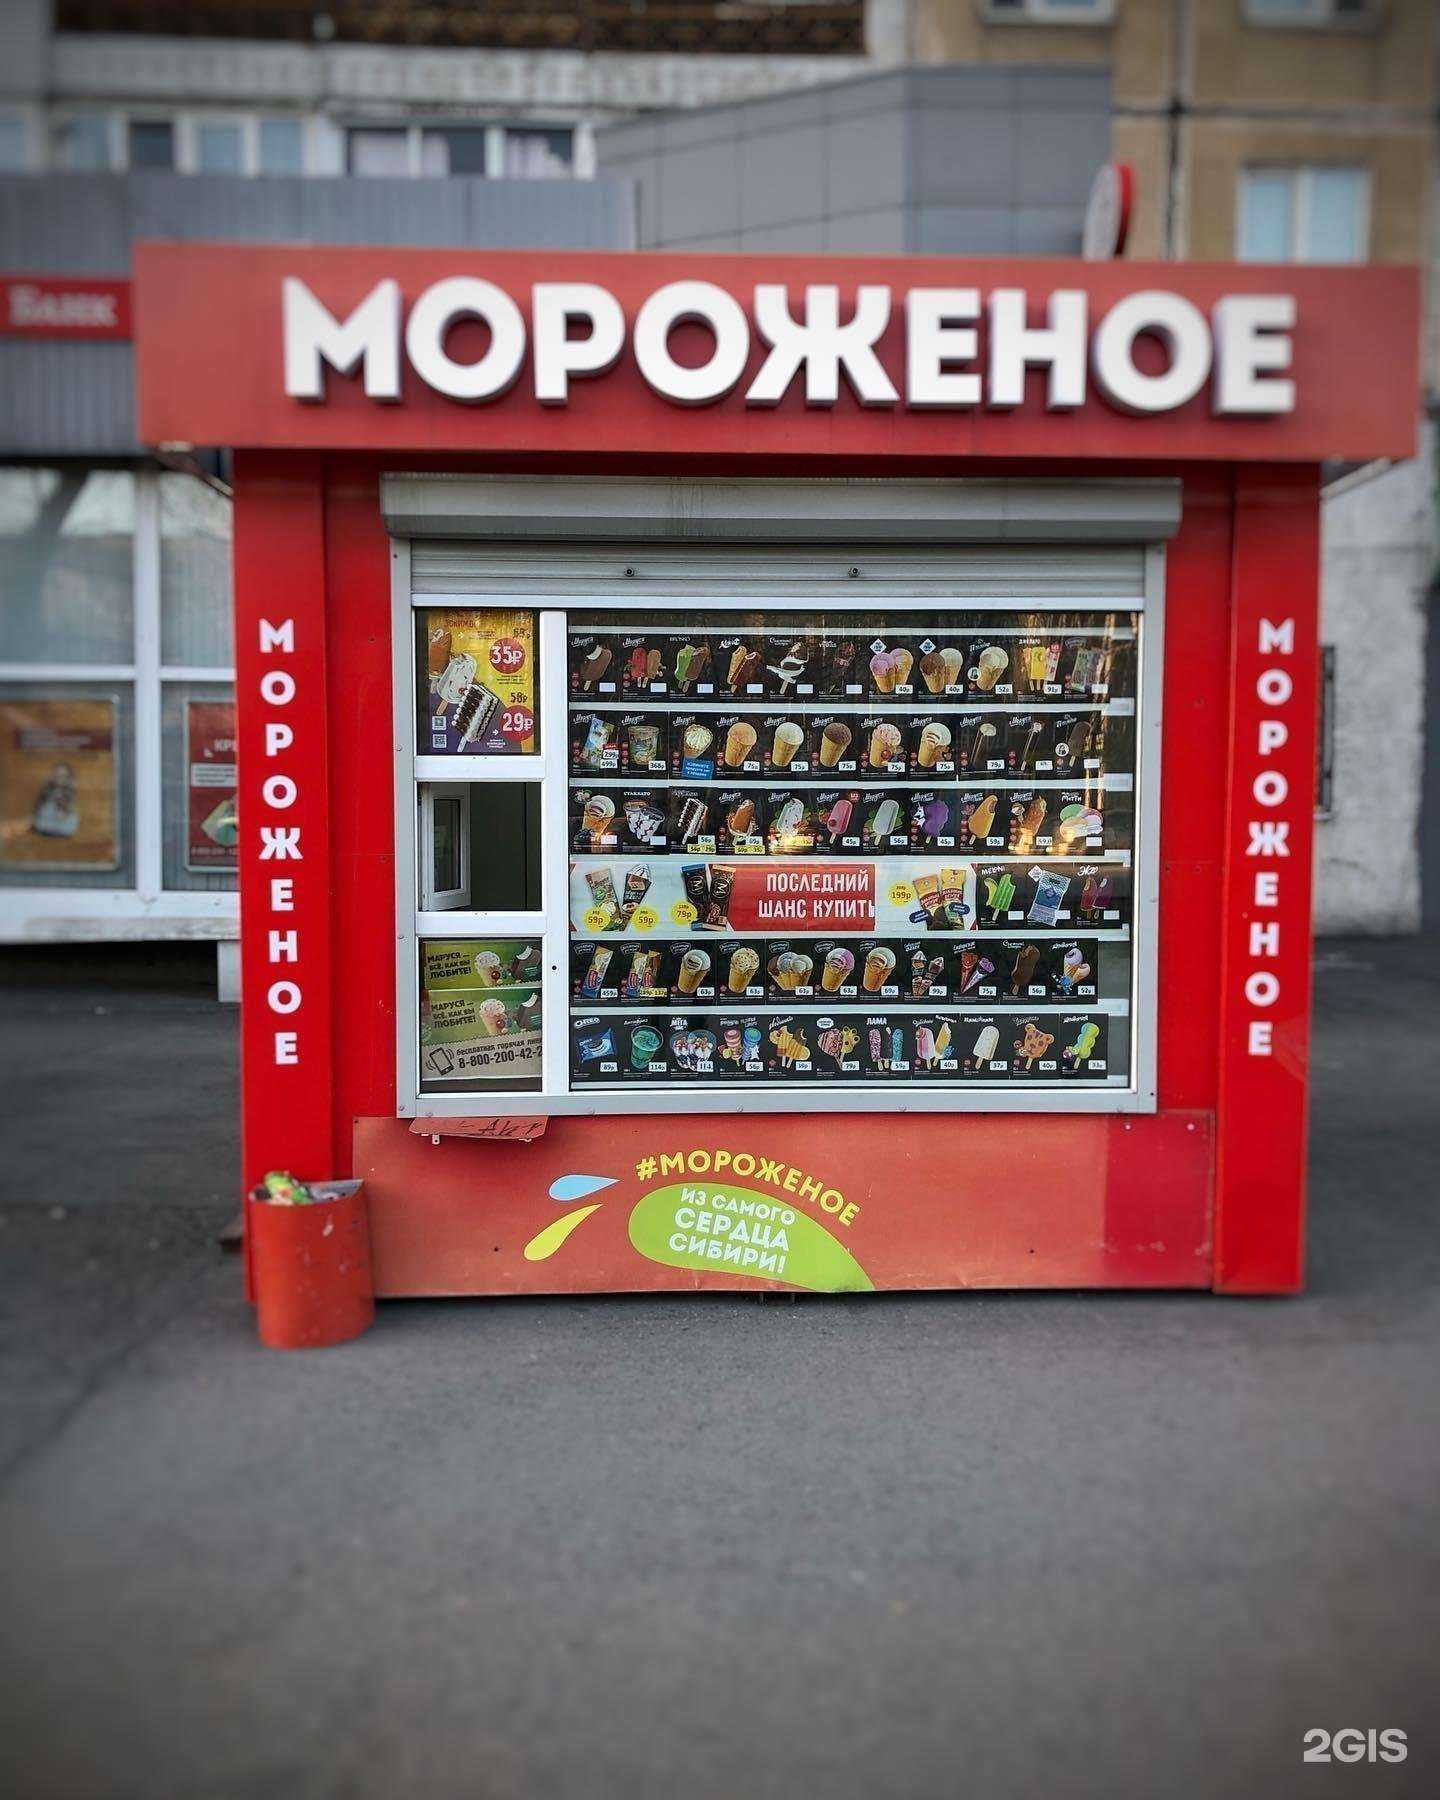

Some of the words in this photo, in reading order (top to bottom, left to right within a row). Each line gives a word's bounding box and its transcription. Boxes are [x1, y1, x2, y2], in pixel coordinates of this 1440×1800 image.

[281, 275, 1297, 415] МОРОЖЕНОЕ
[258, 618, 303, 1065] МОРОЖЕНОЕ
[1245, 617, 1295, 1056] МОРОЖЕНОЕ
[767, 869, 869, 893] ПОСЛЕДНИЙ
[758, 899, 807, 918] ШАНС
[813, 899, 875, 918] КУПИТЬ
[427, 951, 461, 963] МАРУСЯ
[430, 967, 472, 979] ЛЮБИТЕ!
[432, 1000, 466, 1012] МАРУСЯ
[434, 1015, 477, 1029] ЛЮБИТЕ!
[866, 1017, 887, 1025] ЛАМА
[457, 1044, 496, 1056] бесплатная
[497, 1041, 525, 1051] горячая
[635, 1149, 860, 1227] #МОРОЖЕНОЕ
[681, 1187, 706, 1206] ИЗ
[711, 1193, 796, 1225] САМОГО
[674, 1207, 790, 1251] СЕРДЦА
[669, 1232, 787, 1273] СИБИРИ!
